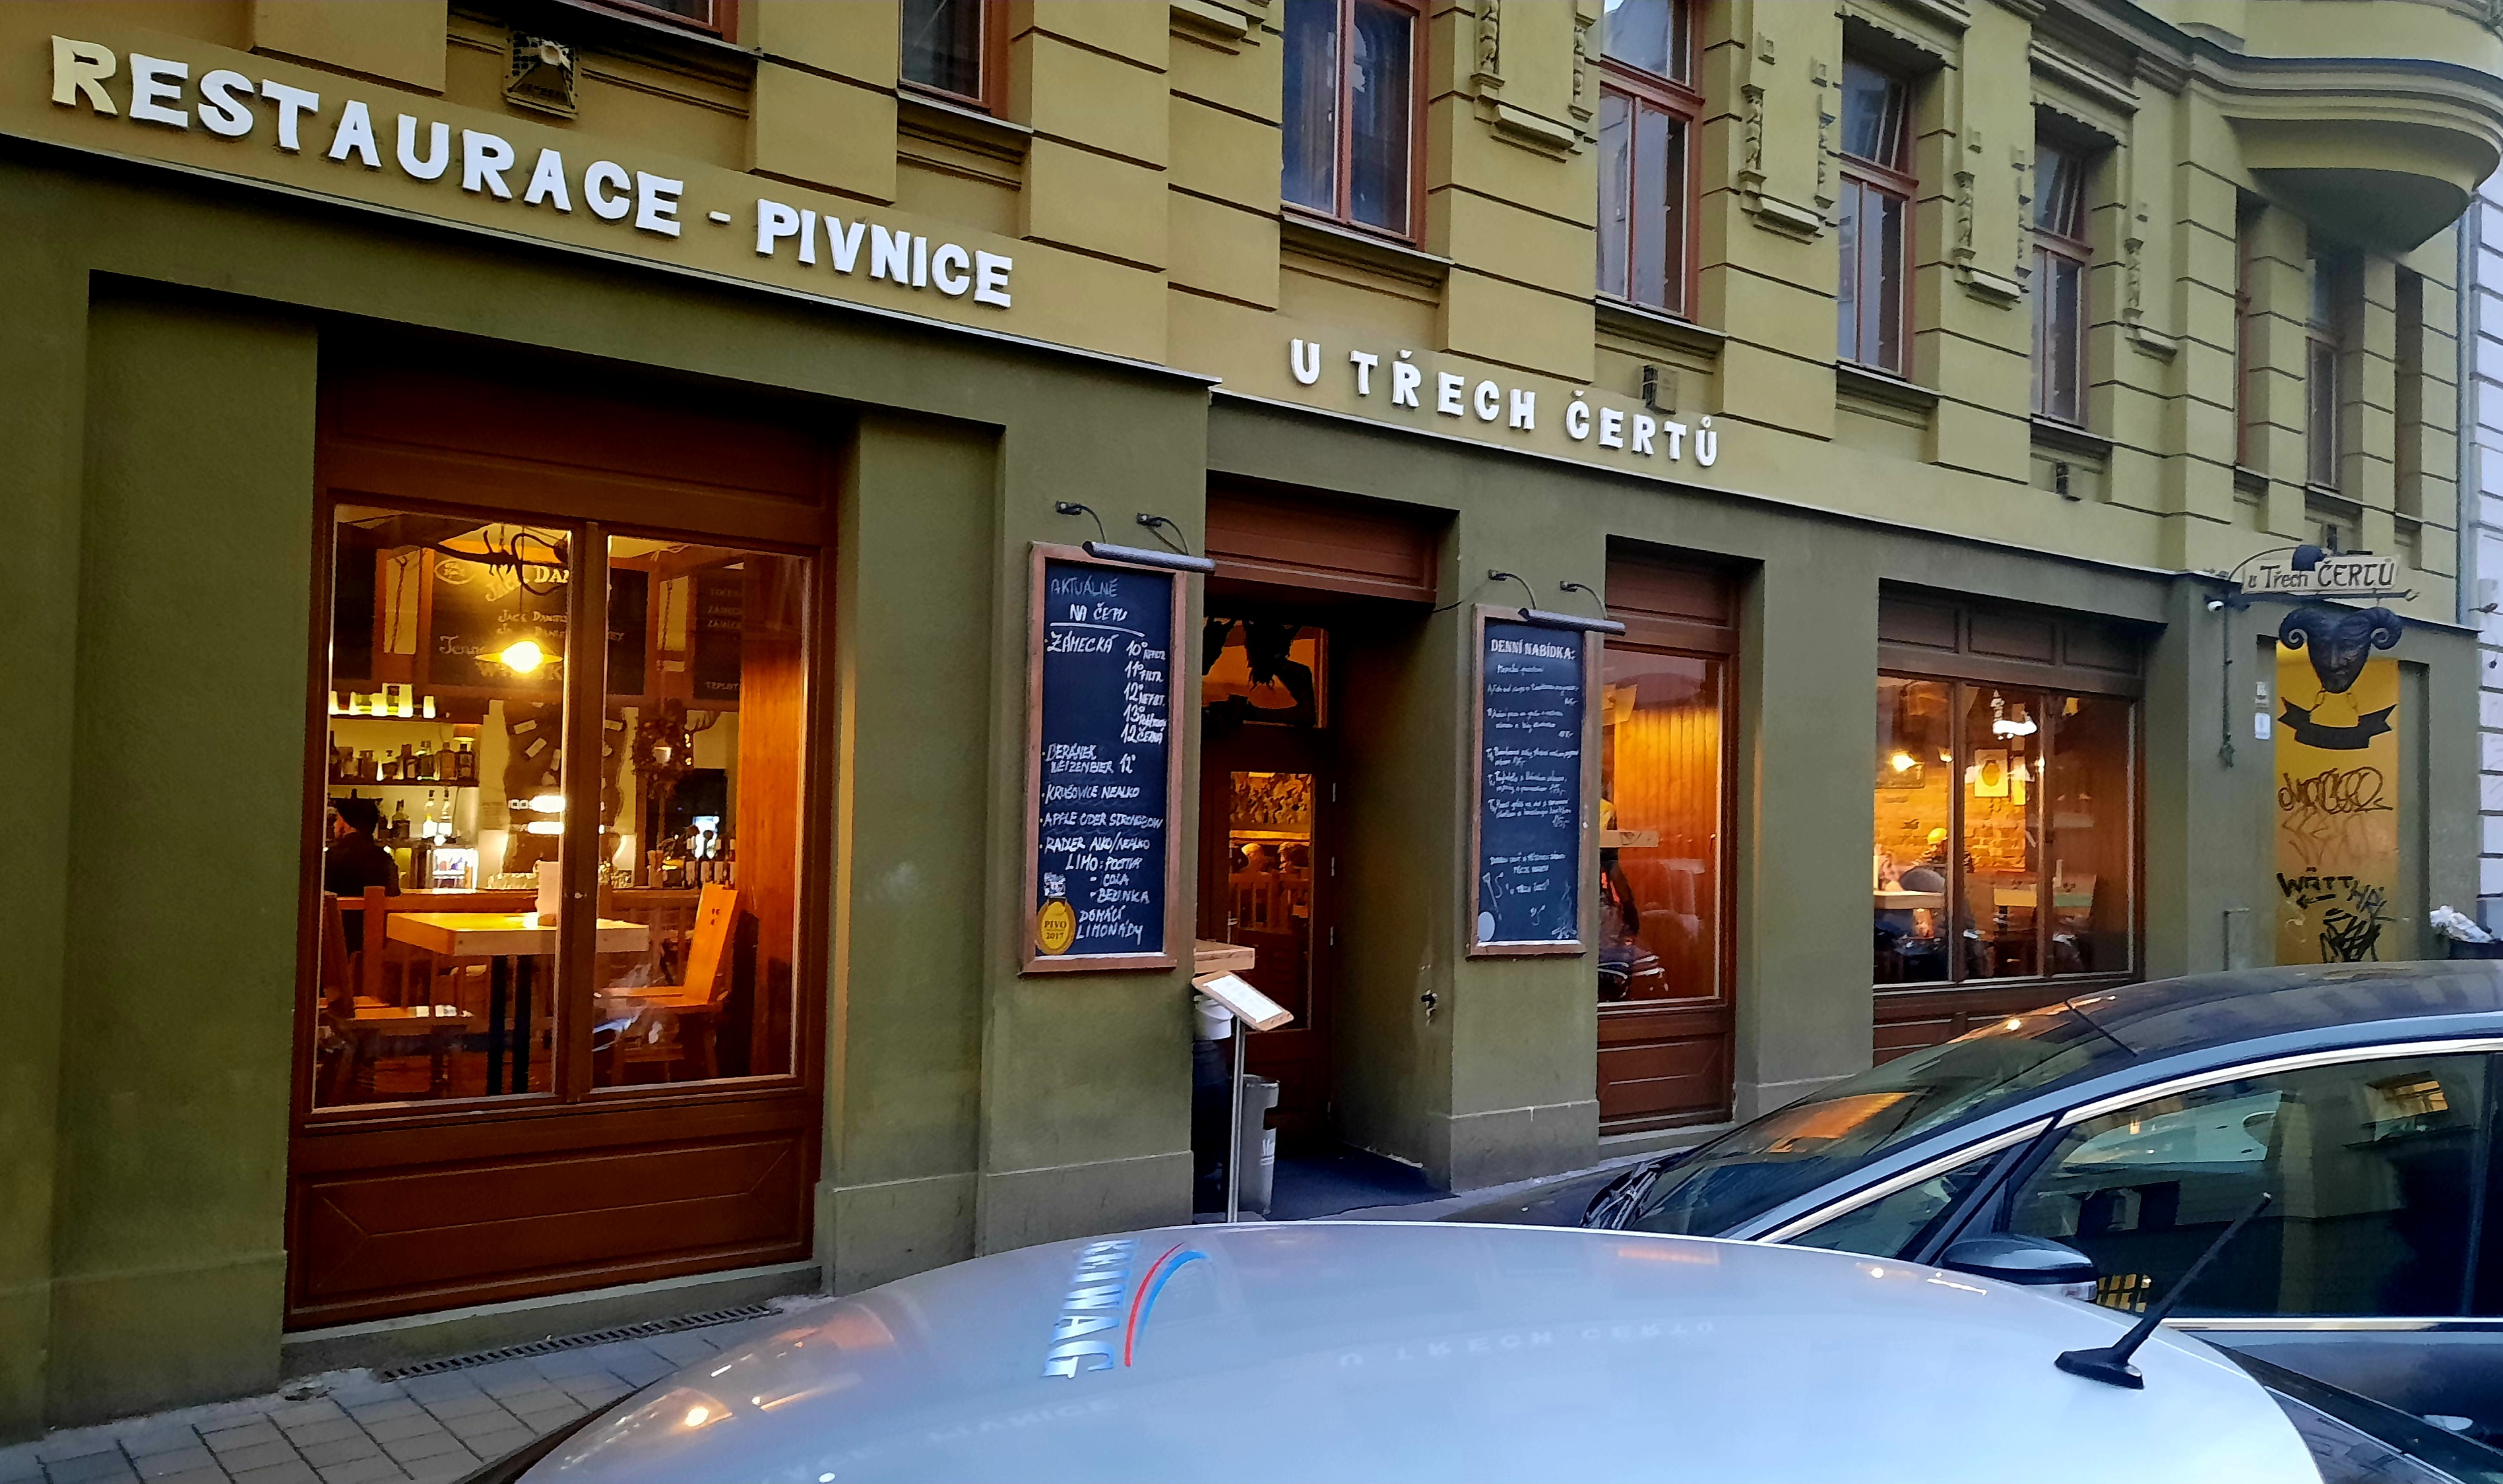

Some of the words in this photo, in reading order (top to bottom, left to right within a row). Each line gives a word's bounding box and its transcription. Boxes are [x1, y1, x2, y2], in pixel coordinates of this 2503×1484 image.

[51, 35, 684, 237] RESTAURACE
[755, 199, 1013, 308] PIVNICE
[1290, 338, 1321, 386] U
[1349, 349, 1537, 431] TŘECH
[1566, 389, 1719, 468] ČERTŮ
[1069, 603, 1088, 622] NA
[1490, 638, 1524, 654] DENNÍ
[1524, 641, 1576, 660] NABÍDKA:
[1044, 920, 1067, 929] PIVO
